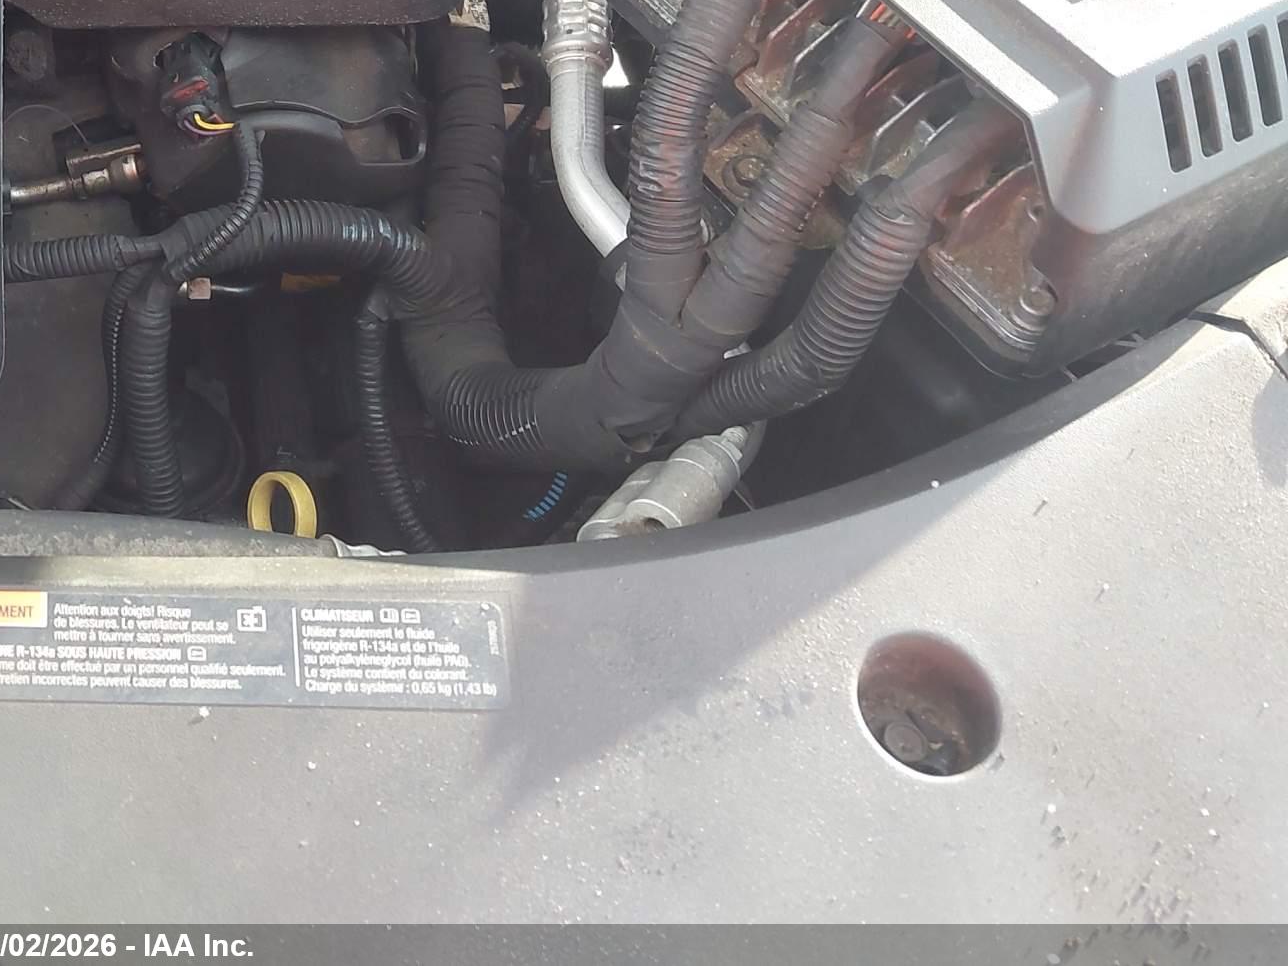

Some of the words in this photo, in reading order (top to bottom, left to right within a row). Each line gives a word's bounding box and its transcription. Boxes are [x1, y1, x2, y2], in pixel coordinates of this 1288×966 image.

[54, 604, 98, 616] Attention
[100, 606, 119, 616] aux
[121, 606, 154, 619] doigts!
[157, 606, 191, 619] Risque
[301, 609, 374, 622] CLIMATISEUR
[54, 617, 67, 628] de
[69, 618, 119, 629] blessures.
[121, 619, 135, 629] Le
[191, 621, 214, 632] peut
[216, 623, 228, 631] se
[54, 630, 87, 640] mettre
[137, 633, 161, 644] sans
[163, 632, 236, 644] avertissement.
[339, 627, 392, 639] seulement
[395, 628, 404, 639] le
[16, 645, 56, 658] R-134a
[57, 646, 86, 658] SOUS
[89, 646, 124, 659] HAUTE
[127, 647, 181, 661] PRESSION
[360, 640, 398, 652] R-134a
[400, 641, 411, 653] et
[413, 641, 426, 653] de
[303, 655, 317, 665] au
[16, 659, 36, 671] doit
[38, 659, 58, 672] être
[60, 661, 101, 674] effectué
[104, 663, 121, 675] par
[123, 664, 136, 673] un
[138, 663, 188, 676] personnel
[230, 665, 286, 676] seulement.
[304, 667, 318, 678] Le
[320, 667, 363, 680] système
[409, 668, 422, 680] du
[32, 673, 89, 686] incorrectes
[91, 675, 131, 689] peuvent
[133, 676, 167, 688] causer
[169, 676, 188, 688] des
[191, 676, 242, 689] blessures.
[305, 680, 342, 694] Charge
[344, 681, 358, 693] du
[360, 681, 404, 695] système
[438, 683, 452, 696] kg
[483, 683, 497, 696] lb)
